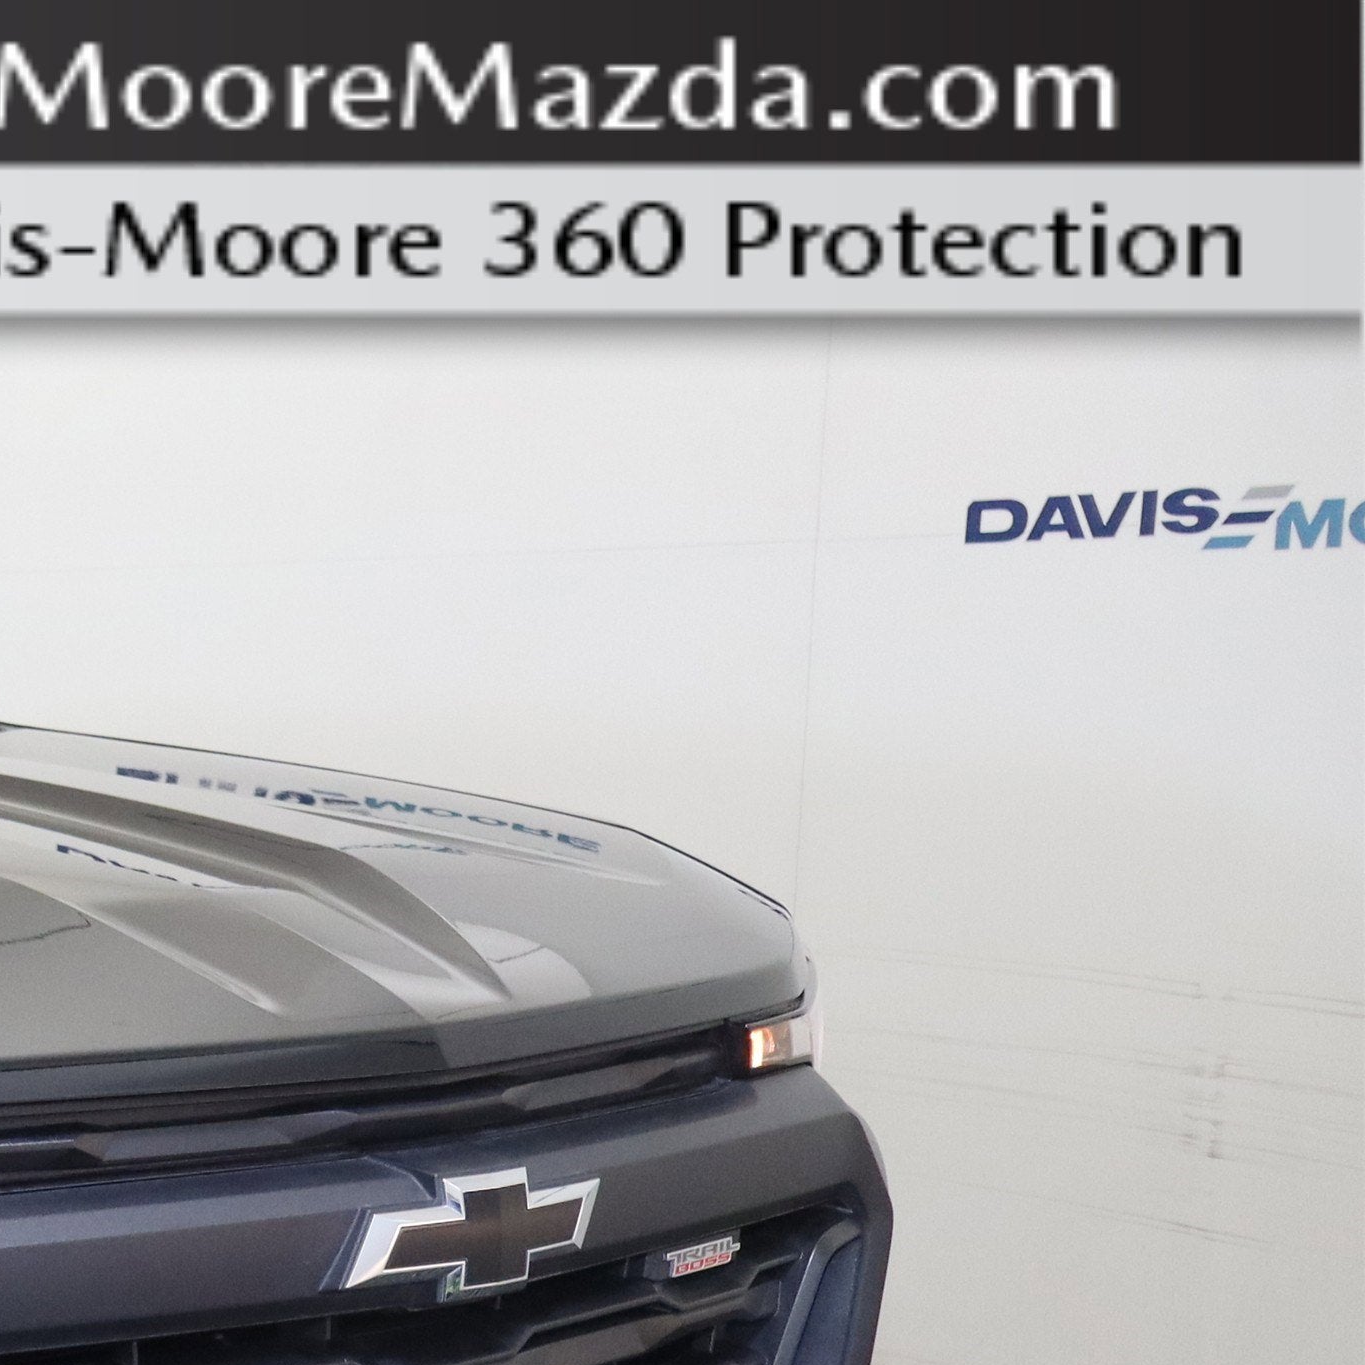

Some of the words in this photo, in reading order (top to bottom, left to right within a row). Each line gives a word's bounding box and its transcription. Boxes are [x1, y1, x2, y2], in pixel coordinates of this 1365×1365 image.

[964, 488, 1221, 543] DAVIS
[667, 1236, 741, 1266] TRAIL
[672, 1252, 732, 1278] BOSS
